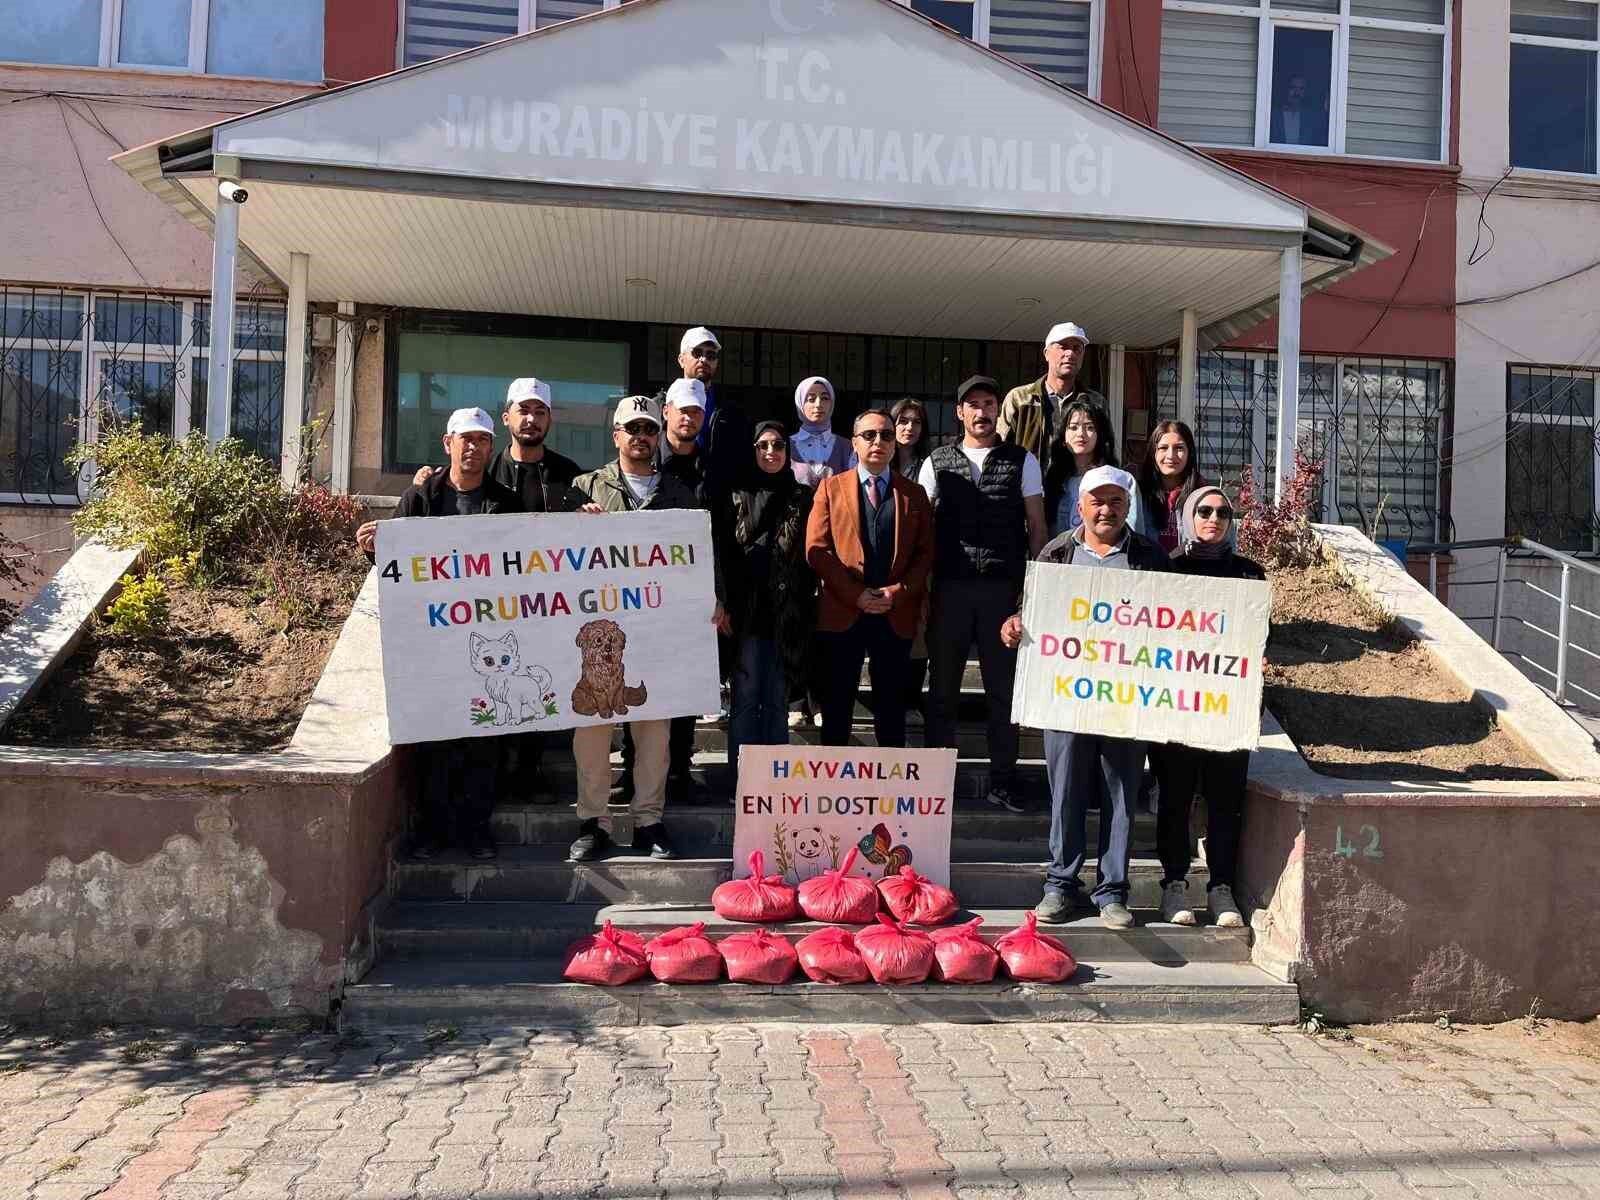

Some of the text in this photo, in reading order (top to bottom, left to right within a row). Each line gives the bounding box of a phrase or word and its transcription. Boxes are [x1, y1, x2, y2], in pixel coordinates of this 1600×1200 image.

[758, 47, 847, 105] T.C.
[445, 94, 1112, 197] MURADİYE KAYMAKAMLIĞI
[381, 544, 695, 583] 4 EKİM HAYVANLARI
[428, 581, 662, 627] KORUMA GÜNÜ
[1070, 597, 1226, 634] DOĞADAKİ
[1040, 633, 1249, 679] DOSTLARIMIZI
[1055, 676, 1229, 714] KORUYALIM
[773, 760, 920, 781] HAYVANLAR
[743, 793, 946, 815] EN İYİ DOSTUMUZ
[1335, 825, 1383, 858] 42
